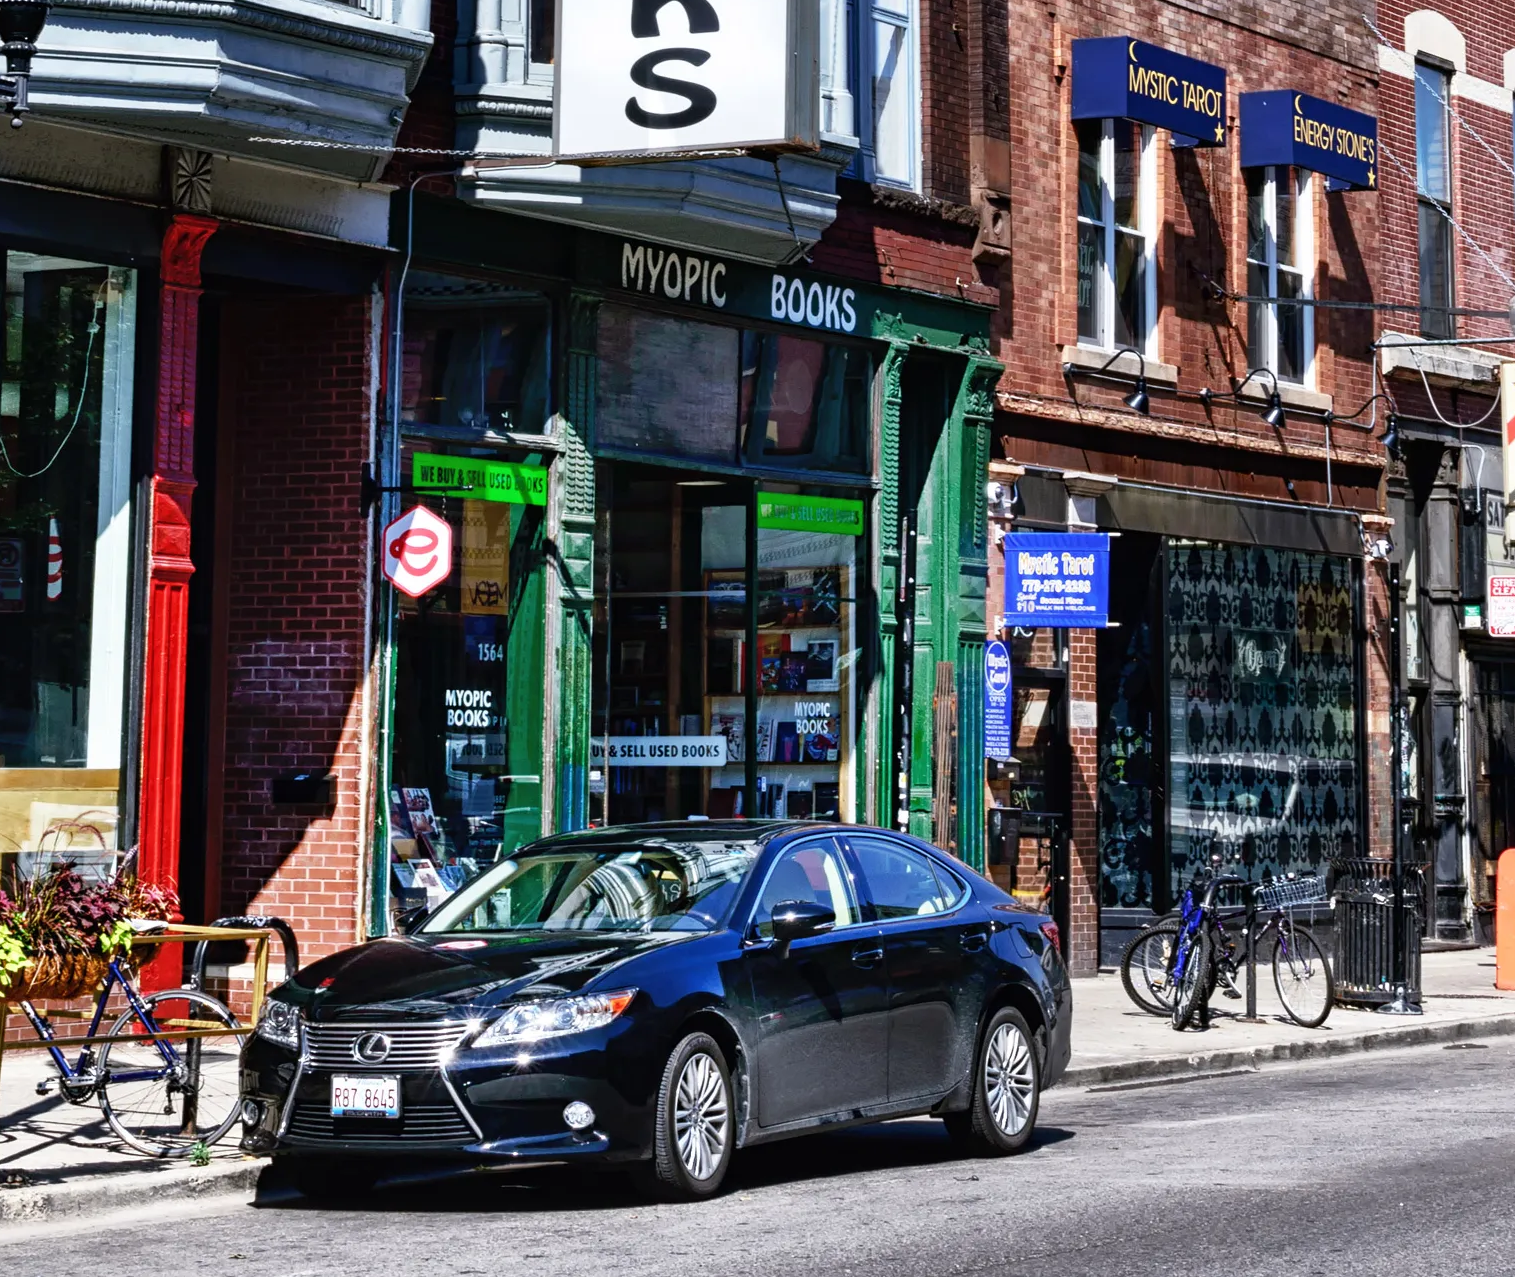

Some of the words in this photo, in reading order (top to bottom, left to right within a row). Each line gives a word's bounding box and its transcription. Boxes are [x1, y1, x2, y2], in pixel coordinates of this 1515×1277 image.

[1129, 64, 1178, 105] MYSTIC
[1182, 80, 1222, 118] TAROT
[1294, 115, 1334, 150] ENERGY
[1336, 128, 1375, 165] STONE'S
[622, 243, 727, 308] MYOPIC
[771, 274, 857, 332] BOOKS
[420, 465, 435, 483] WE
[437, 467, 455, 485] BUY
[457, 470, 465, 487] &
[467, 470, 486, 488] SELL
[489, 473, 512, 490] USED
[514, 476, 543, 493] BOOKS
[1018, 552, 1059, 575] Mystic
[1061, 552, 1095, 575] Tarot
[478, 643, 504, 662] 1564
[445, 689, 492, 707] MYOPIC
[447, 709, 489, 727] BOOKS
[794, 702, 830, 717] MYOPIC
[796, 719, 829, 735] BOOKS
[591, 745, 606, 758] UY
[609, 745, 617, 758] &
[620, 745, 645, 758] SELL
[650, 745, 678, 758] USED
[682, 745, 720, 758] BOOKS
[334, 1087, 357, 1108] R87
[365, 1089, 395, 1108] 8645
